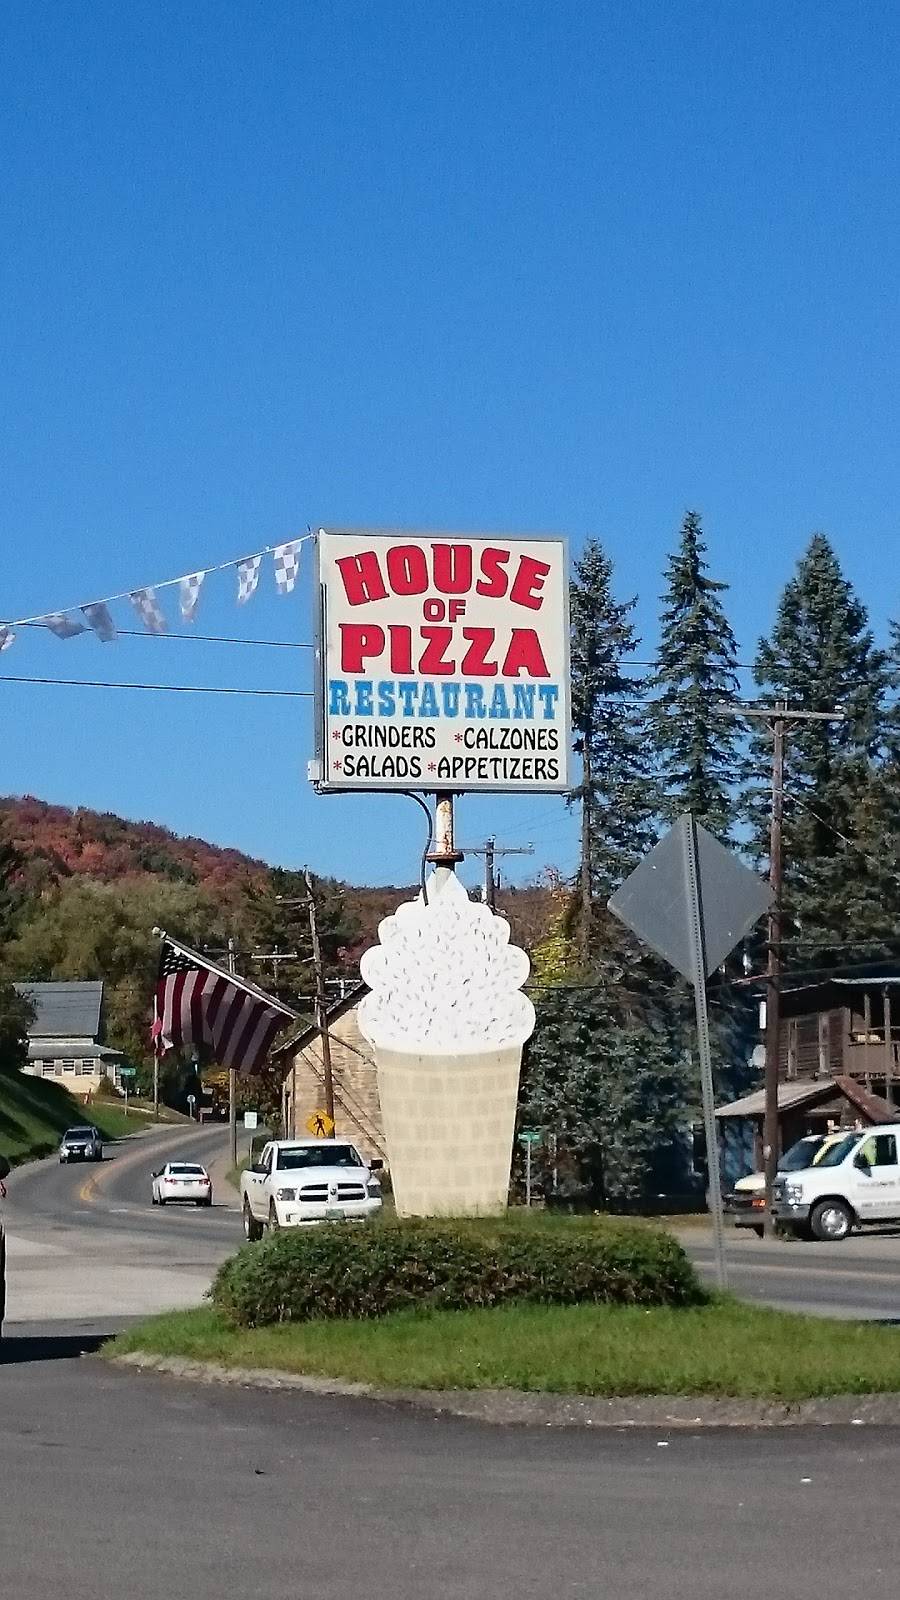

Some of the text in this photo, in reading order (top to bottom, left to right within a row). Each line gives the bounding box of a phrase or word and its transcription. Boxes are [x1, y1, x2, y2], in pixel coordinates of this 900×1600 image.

[335, 544, 551, 610] HOUSE
[423, 598, 466, 622] OF
[338, 623, 551, 677] PIZZA
[329, 680, 559, 719] RESTAURANT
[341, 725, 559, 750] GRINDERS CALZONES
[342, 756, 559, 780] SALADS APPETIZERS
